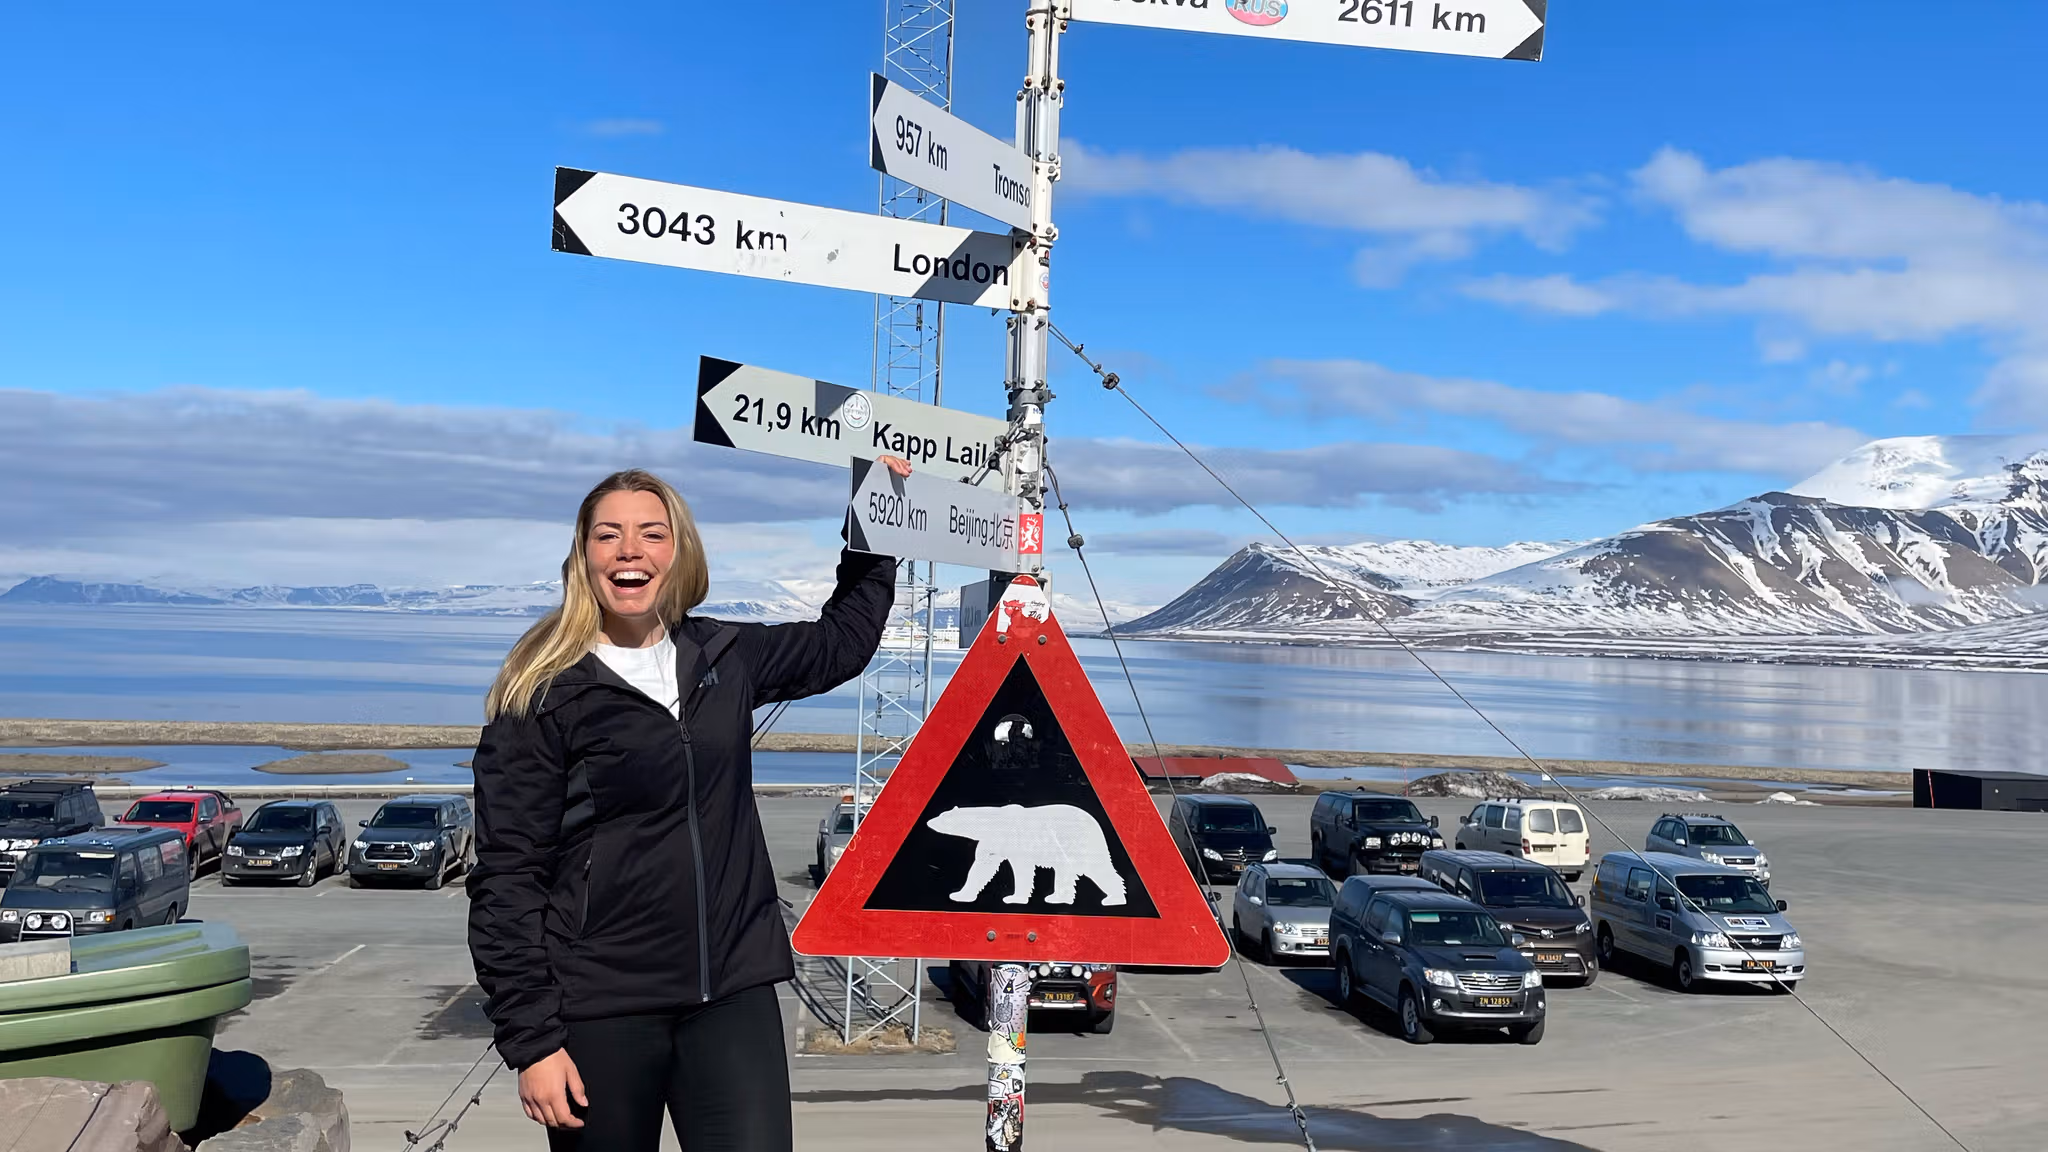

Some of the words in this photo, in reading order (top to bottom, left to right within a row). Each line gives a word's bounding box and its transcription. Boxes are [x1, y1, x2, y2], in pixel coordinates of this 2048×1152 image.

[1233, 0, 1281, 17] RUS
[1338, 0, 1414, 27] 2611
[1432, 3, 1486, 33] km
[895, 114, 923, 158] 957
[928, 130, 948, 171] km
[617, 202, 716, 246] 3043
[736, 219, 788, 252] km
[893, 243, 1009, 287] London
[732, 393, 792, 433] 21,9
[801, 406, 841, 441] km
[872, 421, 938, 465] Kapp
[869, 491, 904, 528] 5920
[907, 498, 928, 532] km
[949, 504, 989, 547] Beijing
[989, 512, 1015, 550] 北京
[1480, 997, 1489, 1005] ZN
